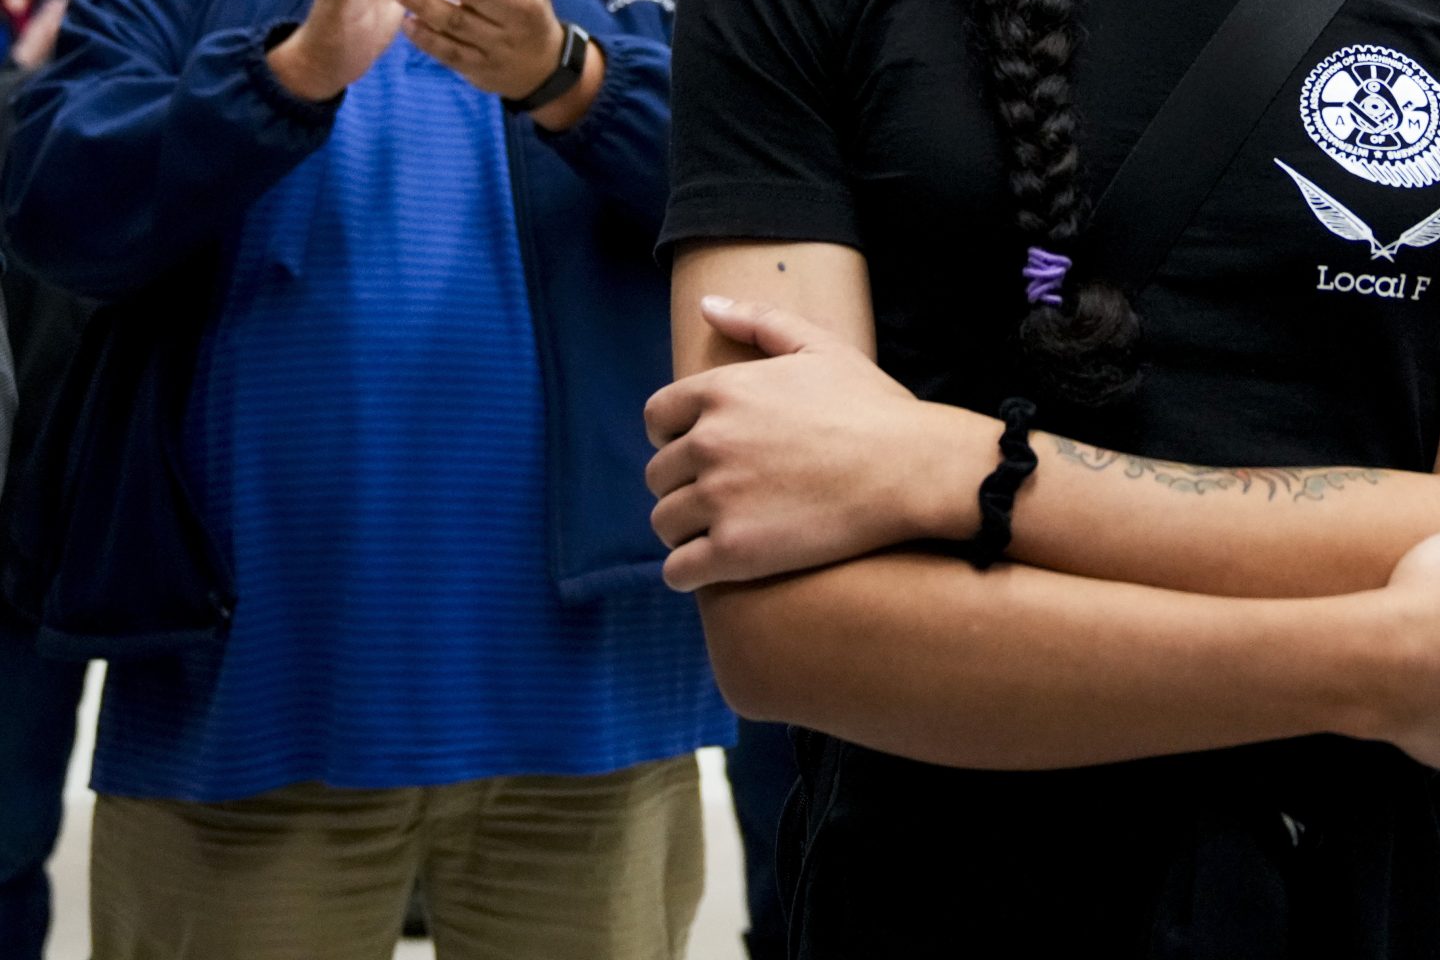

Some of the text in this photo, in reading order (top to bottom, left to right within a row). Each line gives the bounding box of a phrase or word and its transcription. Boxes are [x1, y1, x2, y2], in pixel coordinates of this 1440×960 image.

[1310, 61, 1343, 110] ASSOCIATION
[1342, 55, 1355, 66] OF
[1357, 53, 1414, 76] MACHINISTS
[1408, 119, 1420, 130] M
[1370, 134, 1386, 144] OF
[1317, 265, 1431, 300] Local F
